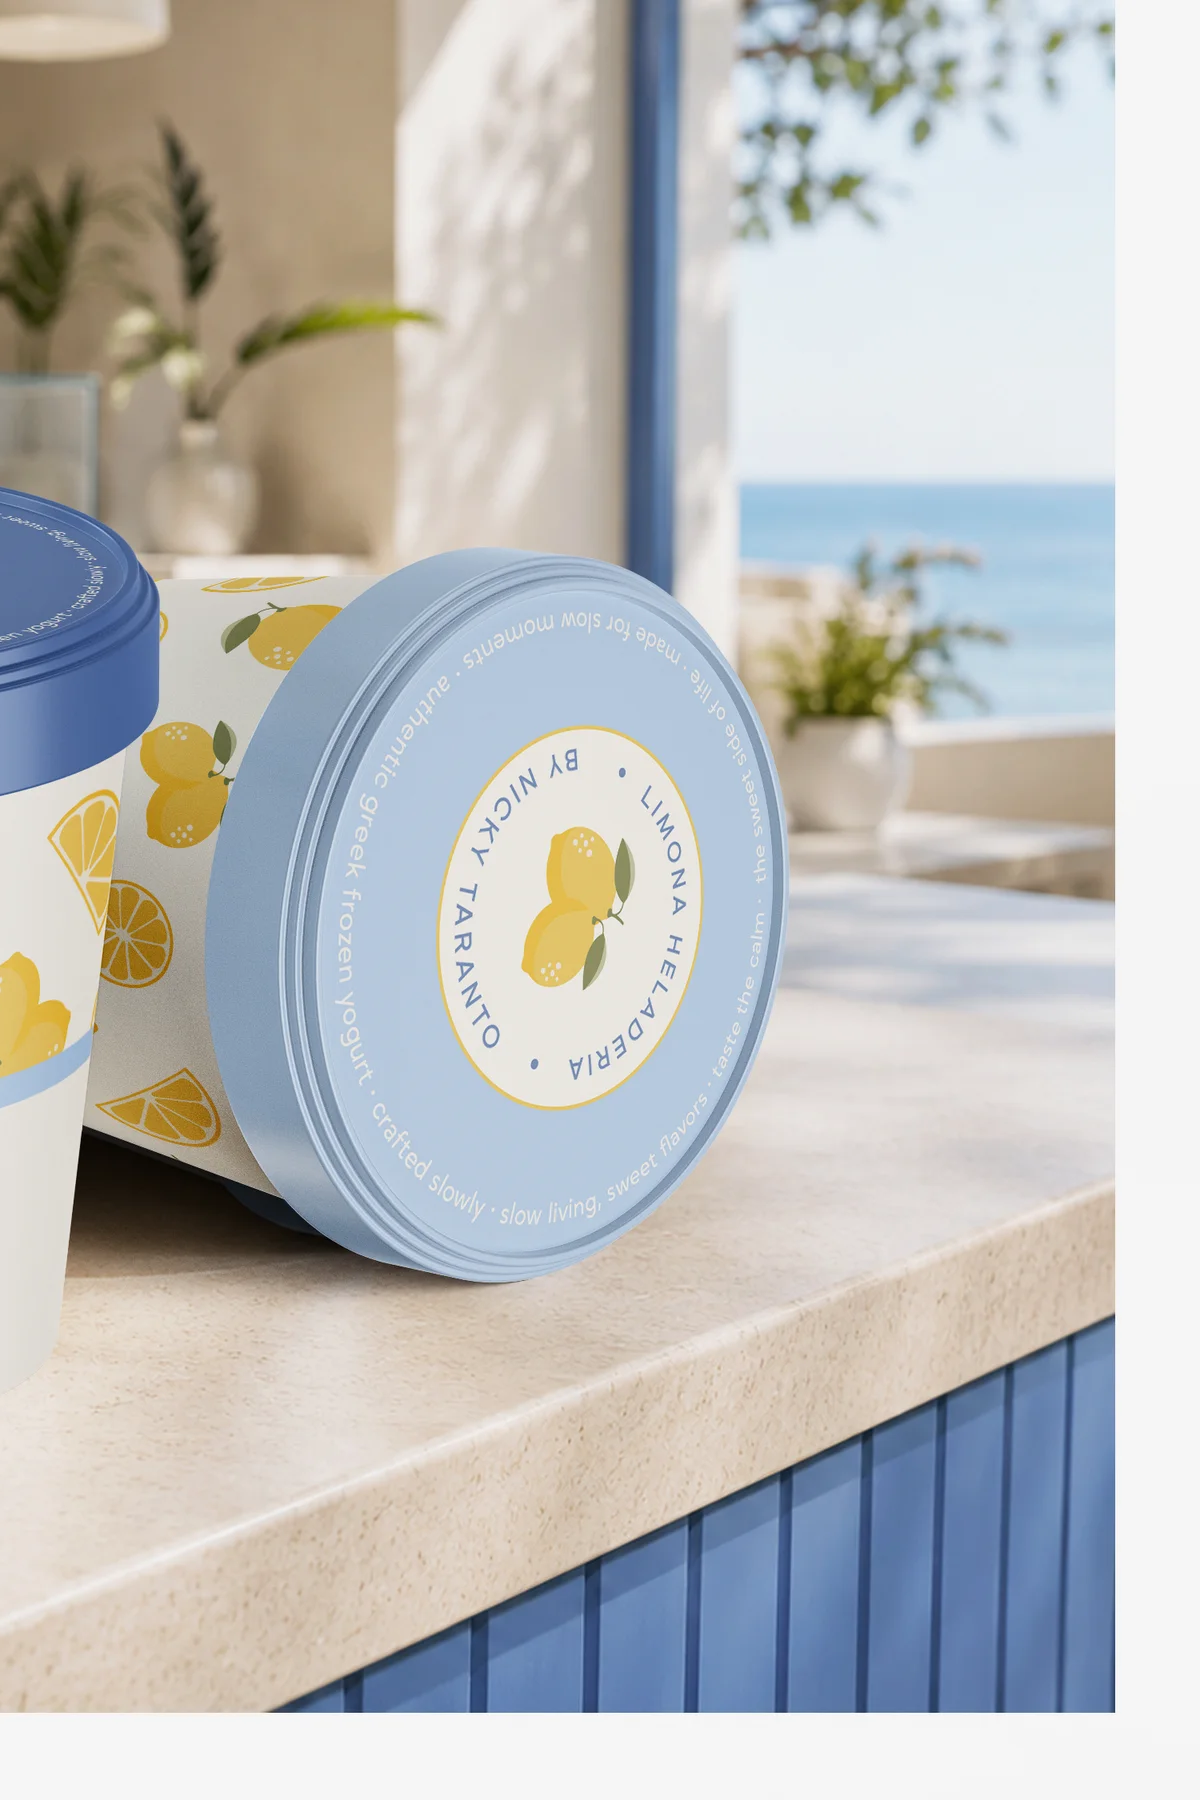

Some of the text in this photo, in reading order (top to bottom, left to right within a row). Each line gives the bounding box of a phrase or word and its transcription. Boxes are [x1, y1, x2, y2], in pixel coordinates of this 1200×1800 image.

[22, 612, 73, 635] yogurt
[334, 611, 767, 1226] the sweet side of life made for slow moments authentic greek frozen yogurt crafted slowly slow living, sweet flavors taste the calm
[454, 748, 579, 1049] BY NICKY TARANTO
[569, 784, 687, 1081] LIMONA HELADERIA
